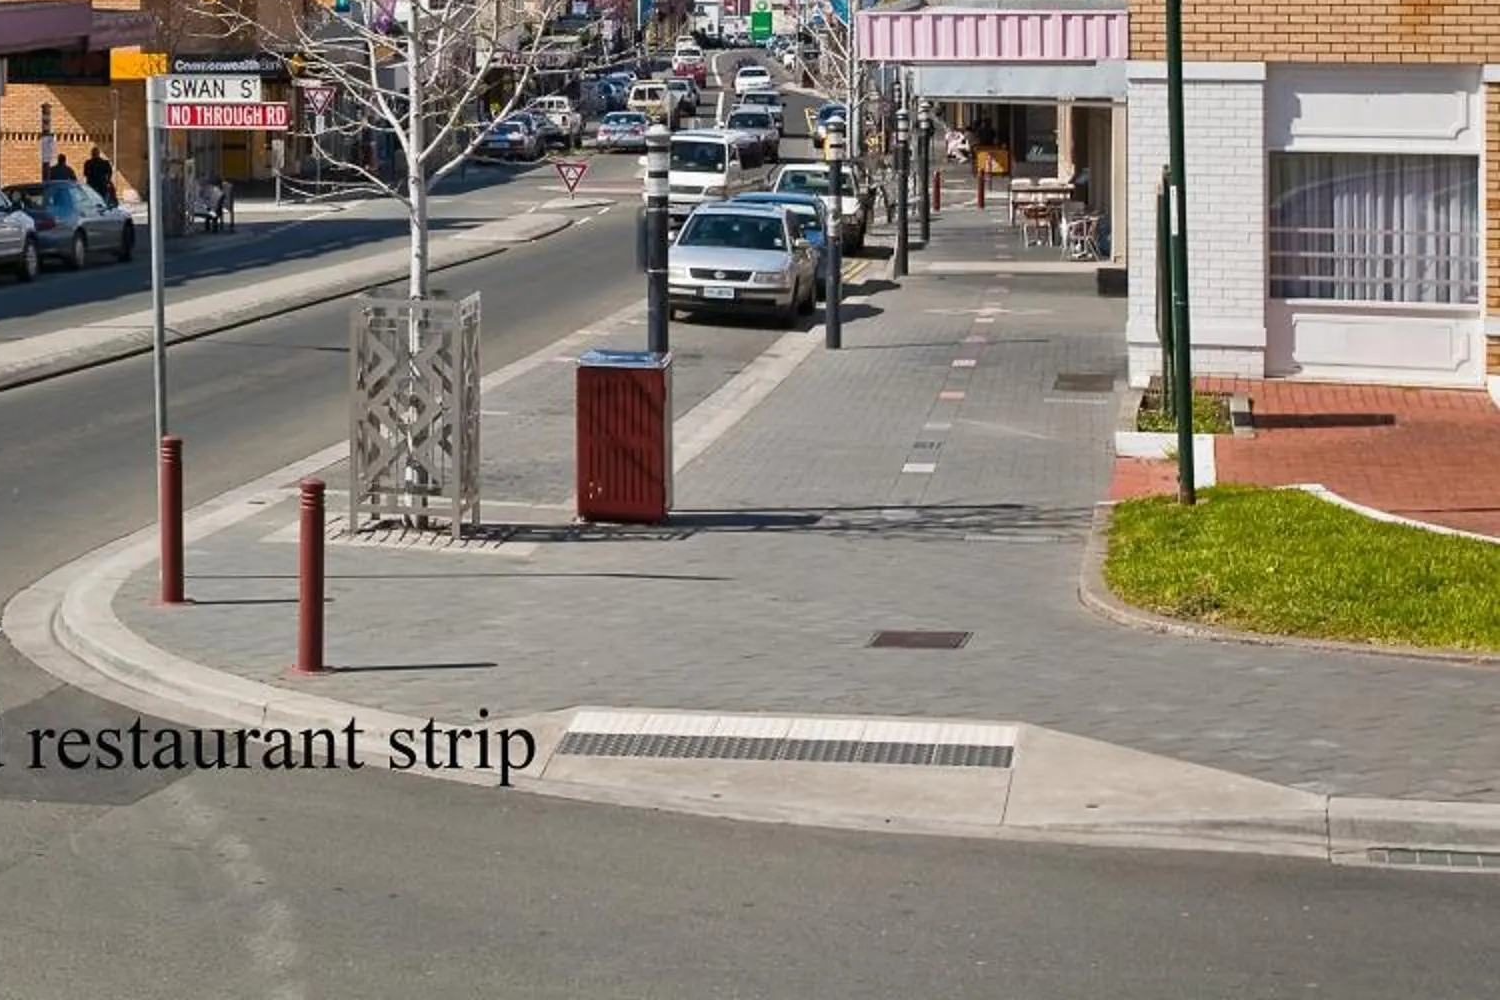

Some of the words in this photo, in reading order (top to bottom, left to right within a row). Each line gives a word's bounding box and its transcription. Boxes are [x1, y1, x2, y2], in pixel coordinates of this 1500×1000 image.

[171, 79, 226, 99] SWAN
[171, 105, 191, 126] NO
[195, 105, 263, 126] THROUGH
[266, 105, 287, 126] RD
